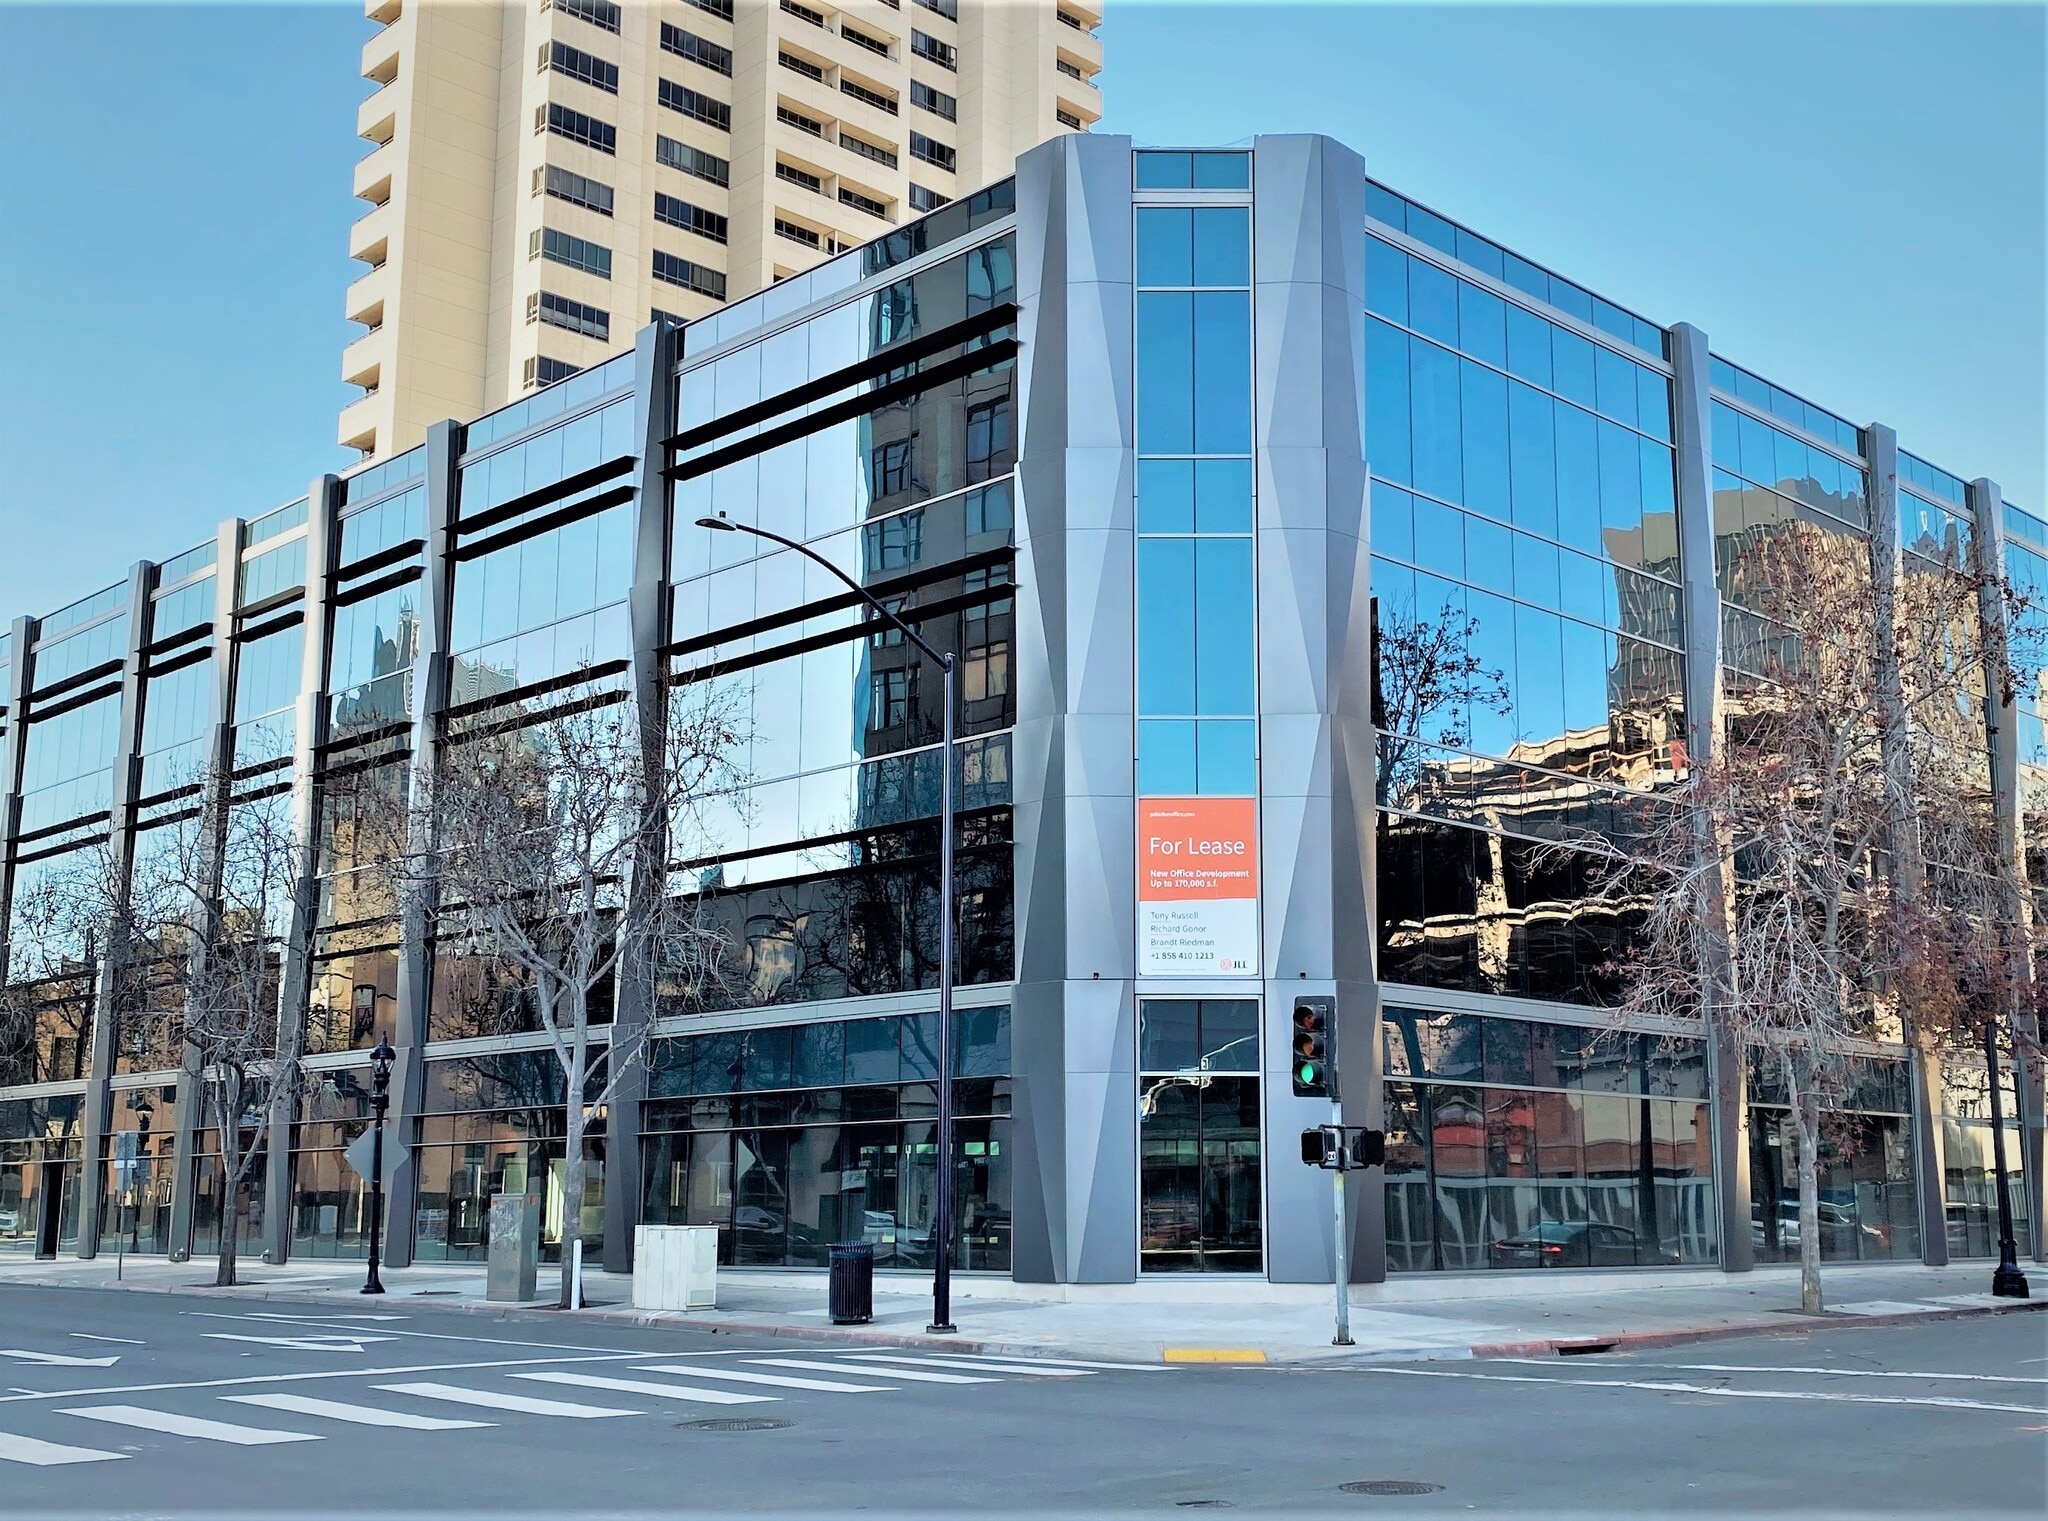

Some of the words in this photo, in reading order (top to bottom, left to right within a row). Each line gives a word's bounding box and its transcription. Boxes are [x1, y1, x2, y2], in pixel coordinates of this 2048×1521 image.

[1150, 837, 1182, 855] For
[1188, 837, 1245, 855] Lease
[1170, 869, 1194, 877] Office
[1196, 870, 1249, 878] Development
[1150, 880, 1162, 888] Up
[1174, 880, 1205, 888] 170,000
[1151, 912, 1169, 921] Tony
[1151, 938, 1177, 946] Brandt
[1233, 960, 1248, 968] JLL
